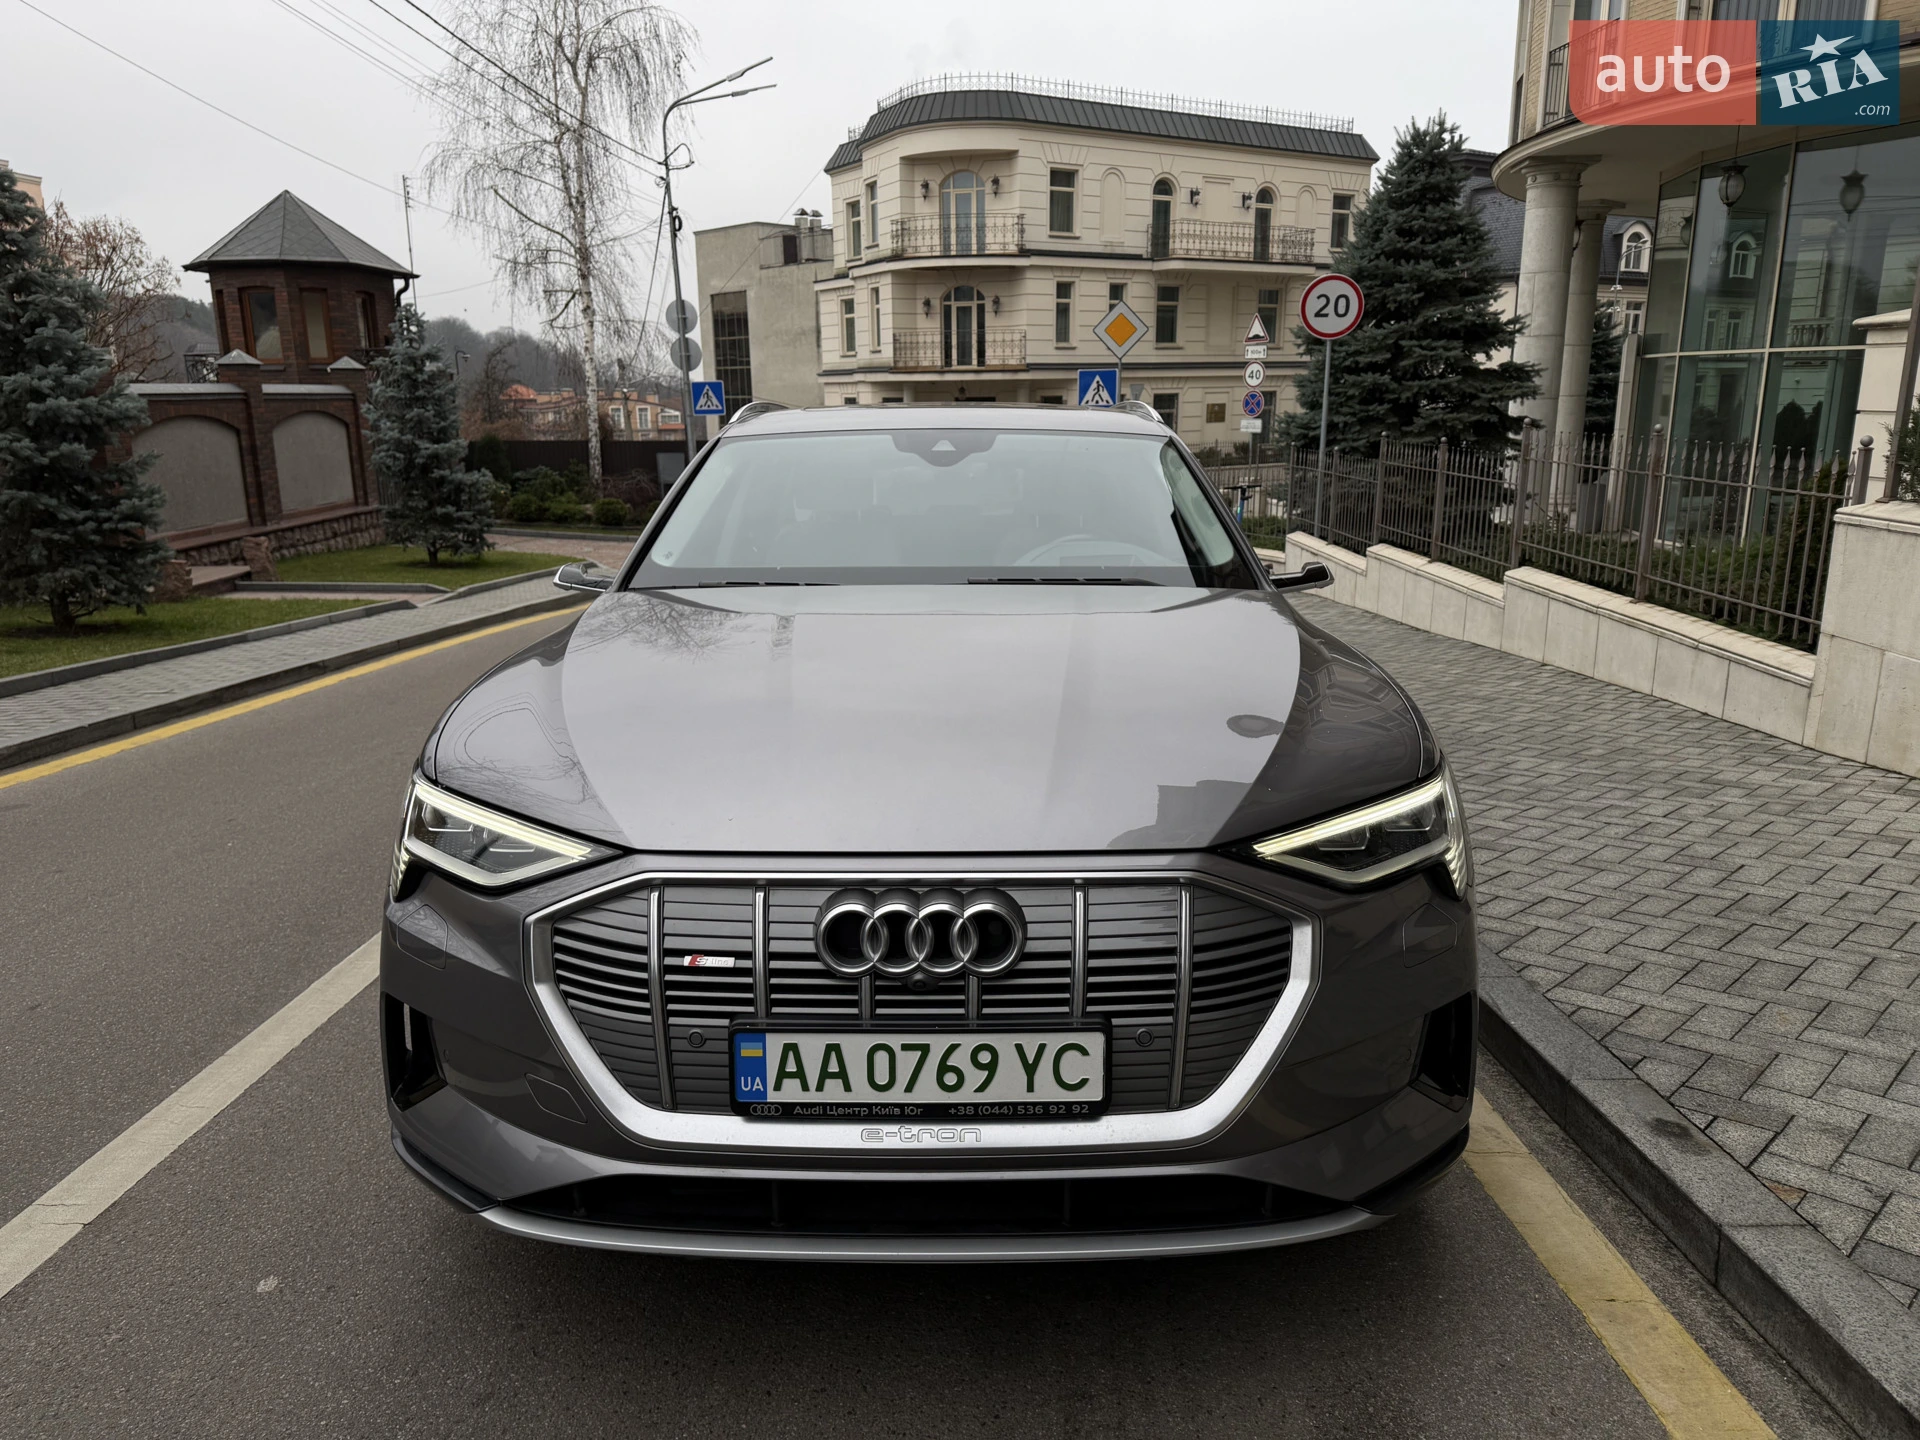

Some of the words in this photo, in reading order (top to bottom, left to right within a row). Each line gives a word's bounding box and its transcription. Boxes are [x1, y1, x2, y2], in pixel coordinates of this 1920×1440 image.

[1313, 293, 1350, 318] 20
[1247, 369, 1261, 380] 40
[772, 1042, 852, 1093] AA
[866, 1042, 999, 1093] 0769
[1014, 1042, 1090, 1093] YC
[741, 1076, 764, 1092] UA
[793, 1105, 823, 1115] Audi
[827, 1106, 869, 1117] Центр
[872, 1105, 901, 1115] Київ
[905, 1106, 924, 1116] Юг
[948, 1105, 975, 1115] +38
[978, 1105, 1013, 1116] (044)
[1017, 1105, 1044, 1114] 536
[1049, 1104, 1067, 1114] 92
[1072, 1104, 1089, 1114] 92
[860, 1125, 982, 1143] e-tron
